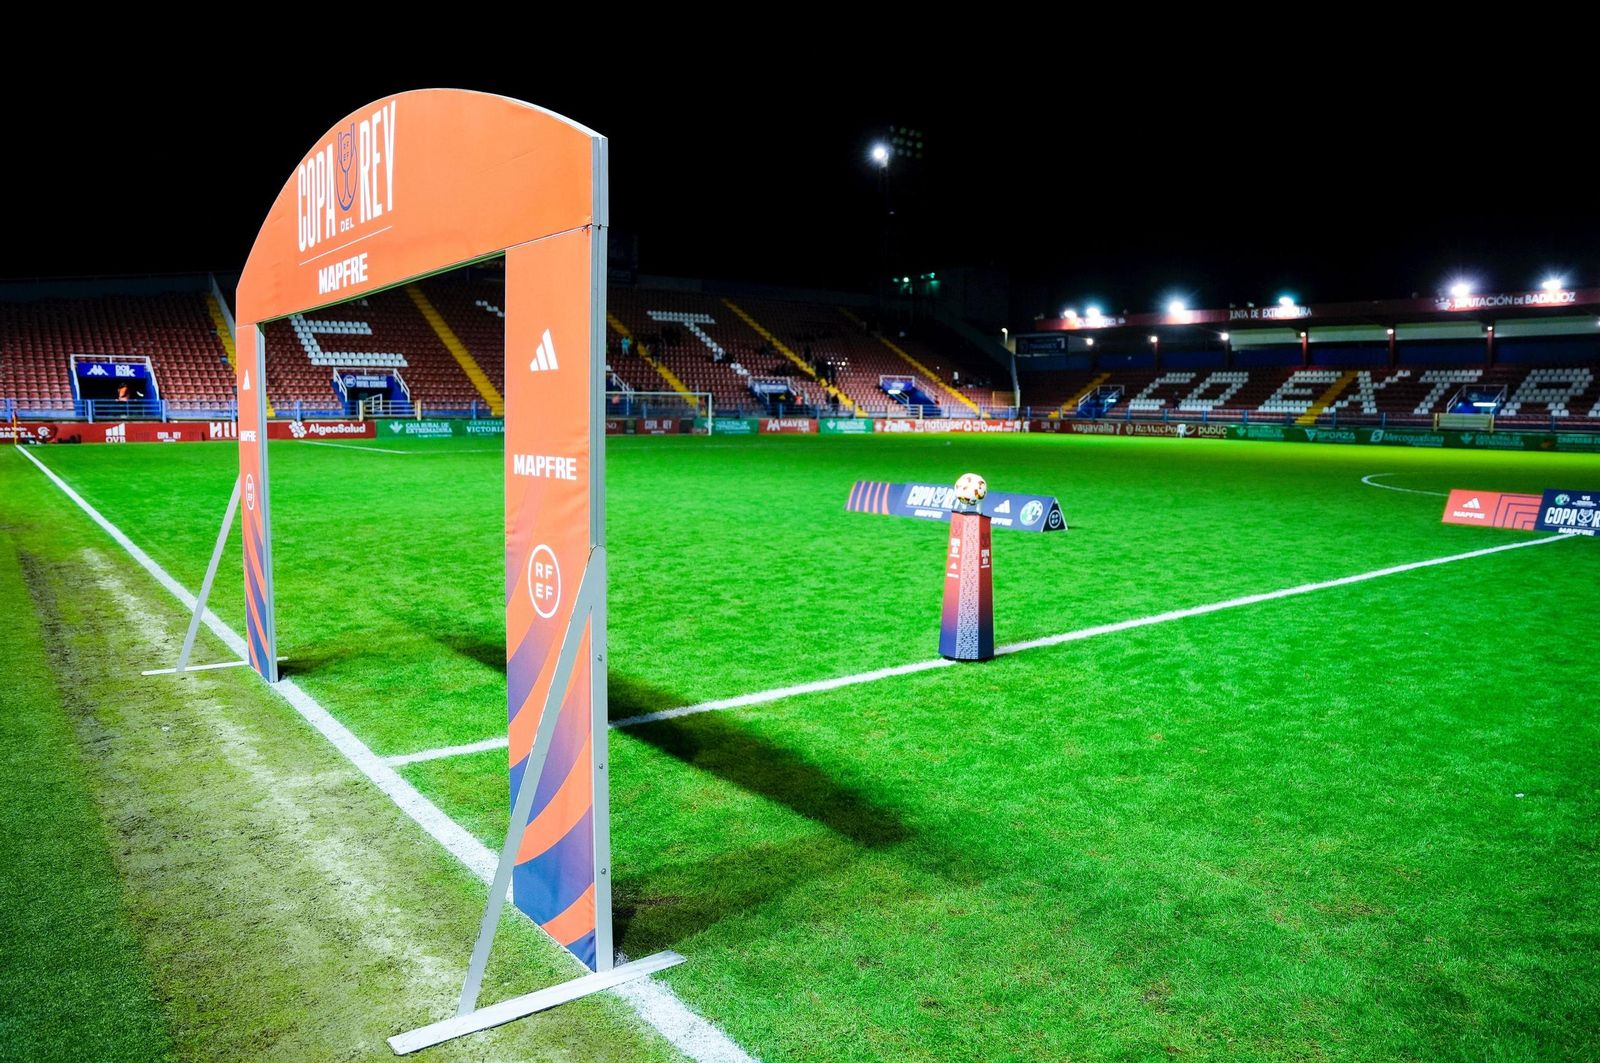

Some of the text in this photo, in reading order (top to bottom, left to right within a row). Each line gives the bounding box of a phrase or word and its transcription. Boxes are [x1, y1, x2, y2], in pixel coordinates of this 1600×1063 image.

[298, 100, 396, 252] COPA REY
[340, 218, 355, 232] DEL
[318, 252, 368, 294] MAPFRE
[308, 423, 367, 435] AlgeaSalud
[513, 453, 577, 480] MAPFRE
[1453, 510, 1486, 520] MAPFRE
[1544, 506, 1577, 526] COPA
[535, 562, 553, 579] RF
[535, 583, 554, 600] EF
